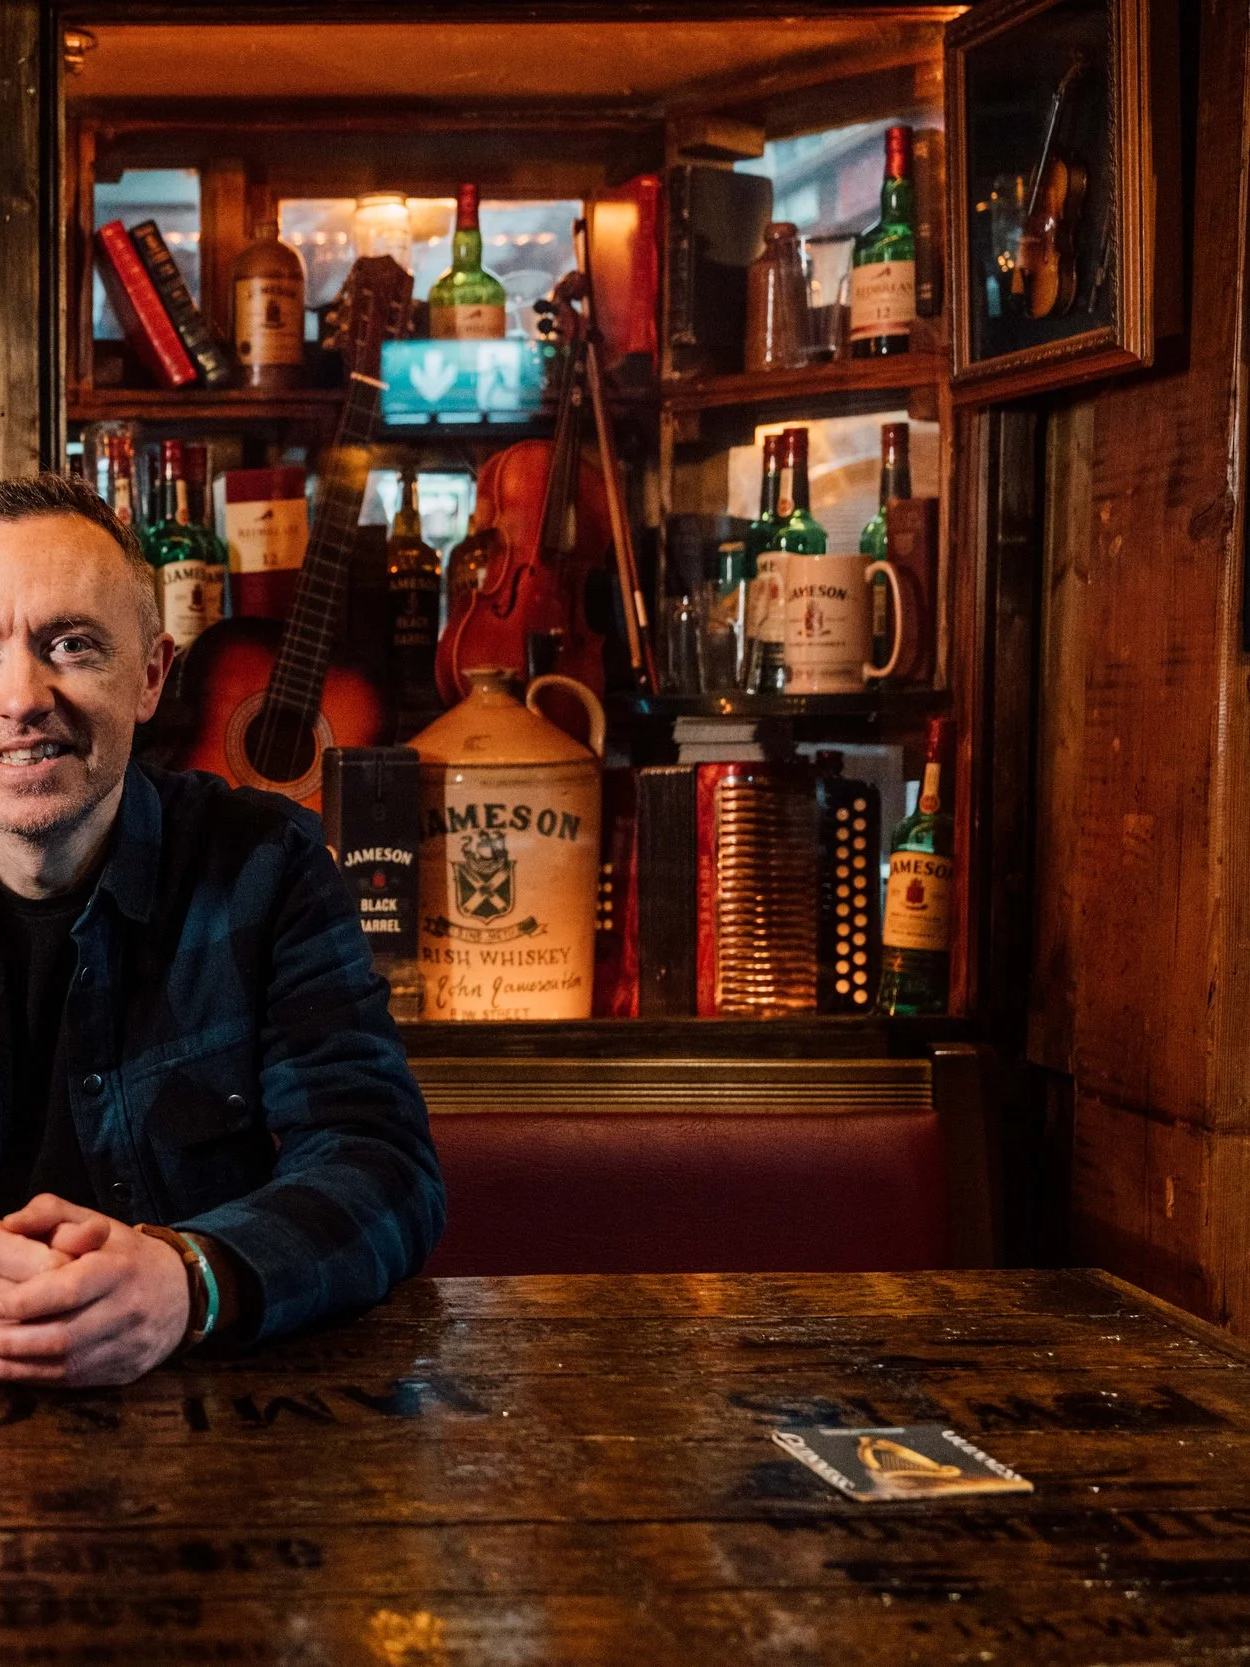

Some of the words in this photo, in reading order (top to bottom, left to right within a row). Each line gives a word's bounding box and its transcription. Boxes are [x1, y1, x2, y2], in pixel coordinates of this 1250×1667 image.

[423, 803, 582, 841] AMESON
[344, 847, 413, 867] JAMESON
[361, 898, 399, 912] BLACK
[422, 947, 470, 968] RISH
[479, 946, 572, 966] WHISKEY
